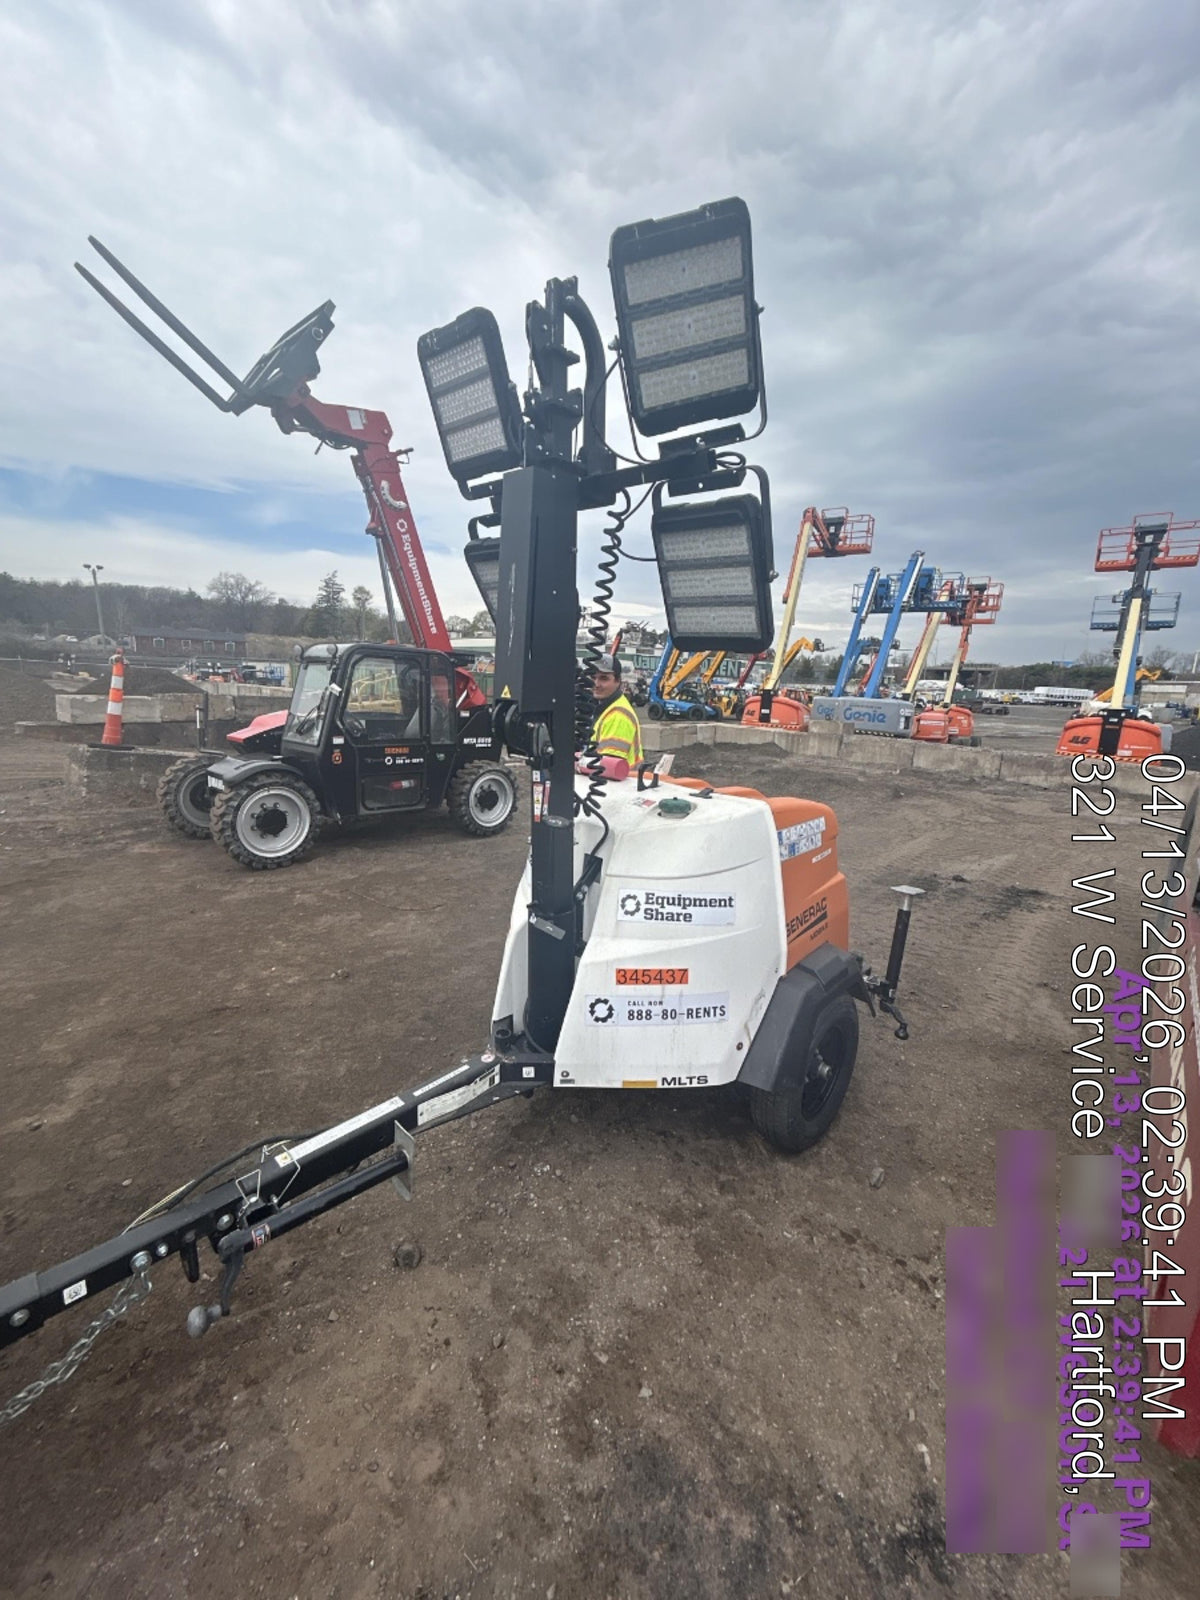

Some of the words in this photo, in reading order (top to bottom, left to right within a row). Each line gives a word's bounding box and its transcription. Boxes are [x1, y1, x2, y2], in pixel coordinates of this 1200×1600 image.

[402, 533, 437, 635] EquipmentShare
[843, 707, 887, 724] Genie
[1068, 735, 1092, 745] JLG
[644, 892, 735, 910] Equipment
[643, 907, 693, 923] Share
[616, 968, 688, 985] 345437
[627, 1004, 727, 1021] 888-80-RENTS
[661, 1075, 709, 1086] MLTS
